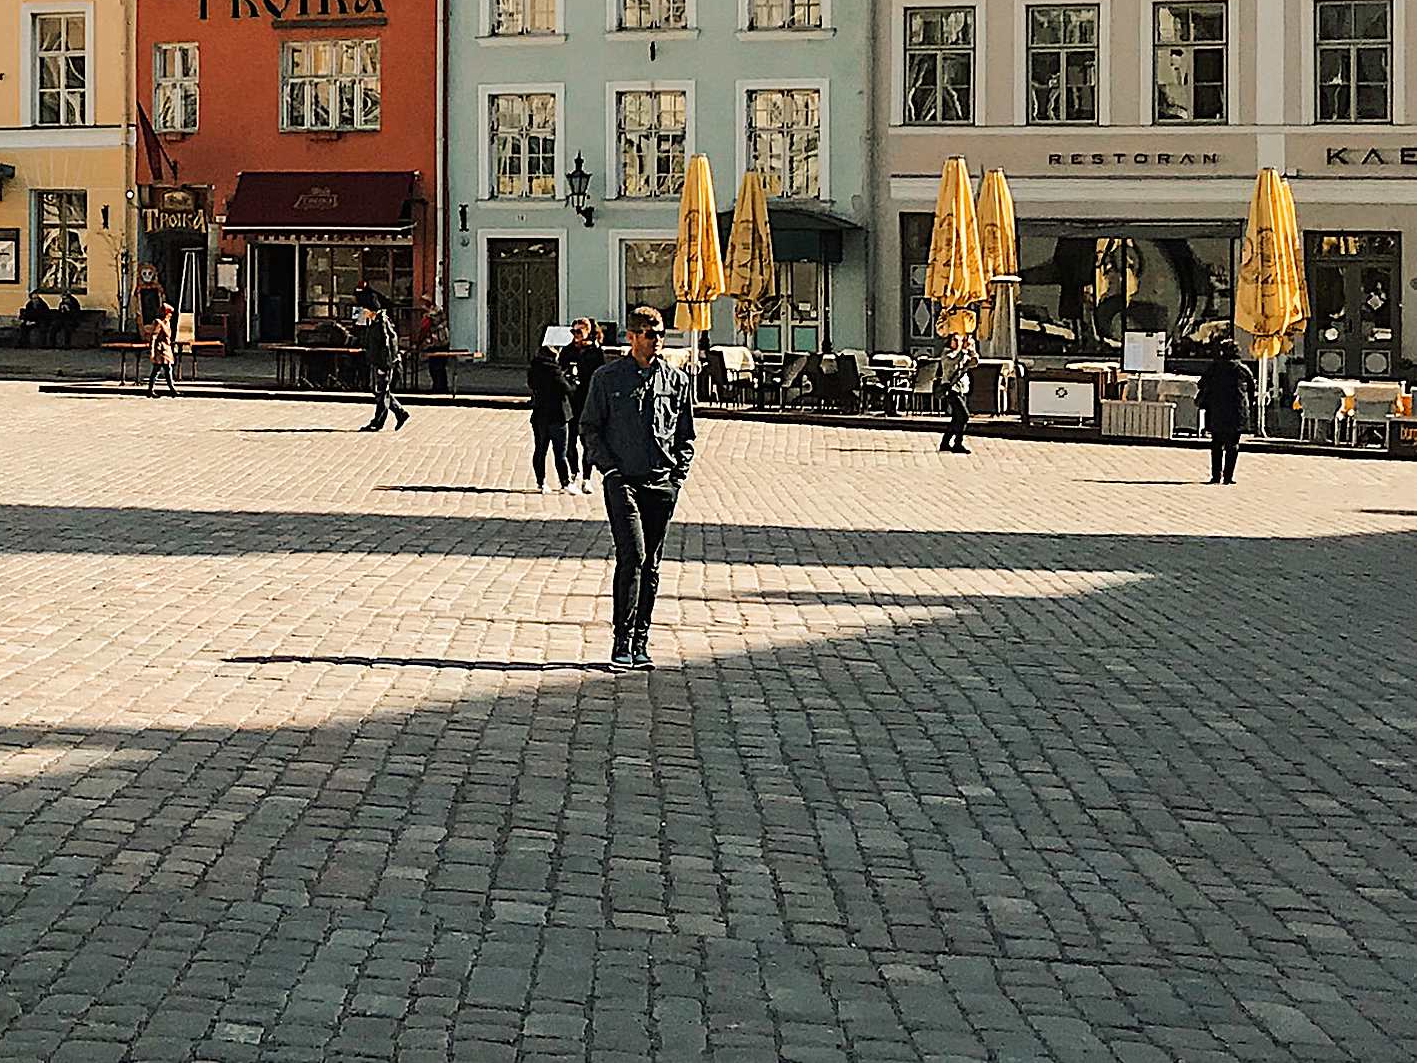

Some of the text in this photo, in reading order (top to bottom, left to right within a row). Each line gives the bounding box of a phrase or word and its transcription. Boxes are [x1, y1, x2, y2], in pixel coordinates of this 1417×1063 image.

[1048, 153, 1219, 165] RESTORAN
[1326, 147, 1417, 165] KAE
[142, 208, 207, 234] TROIKA
